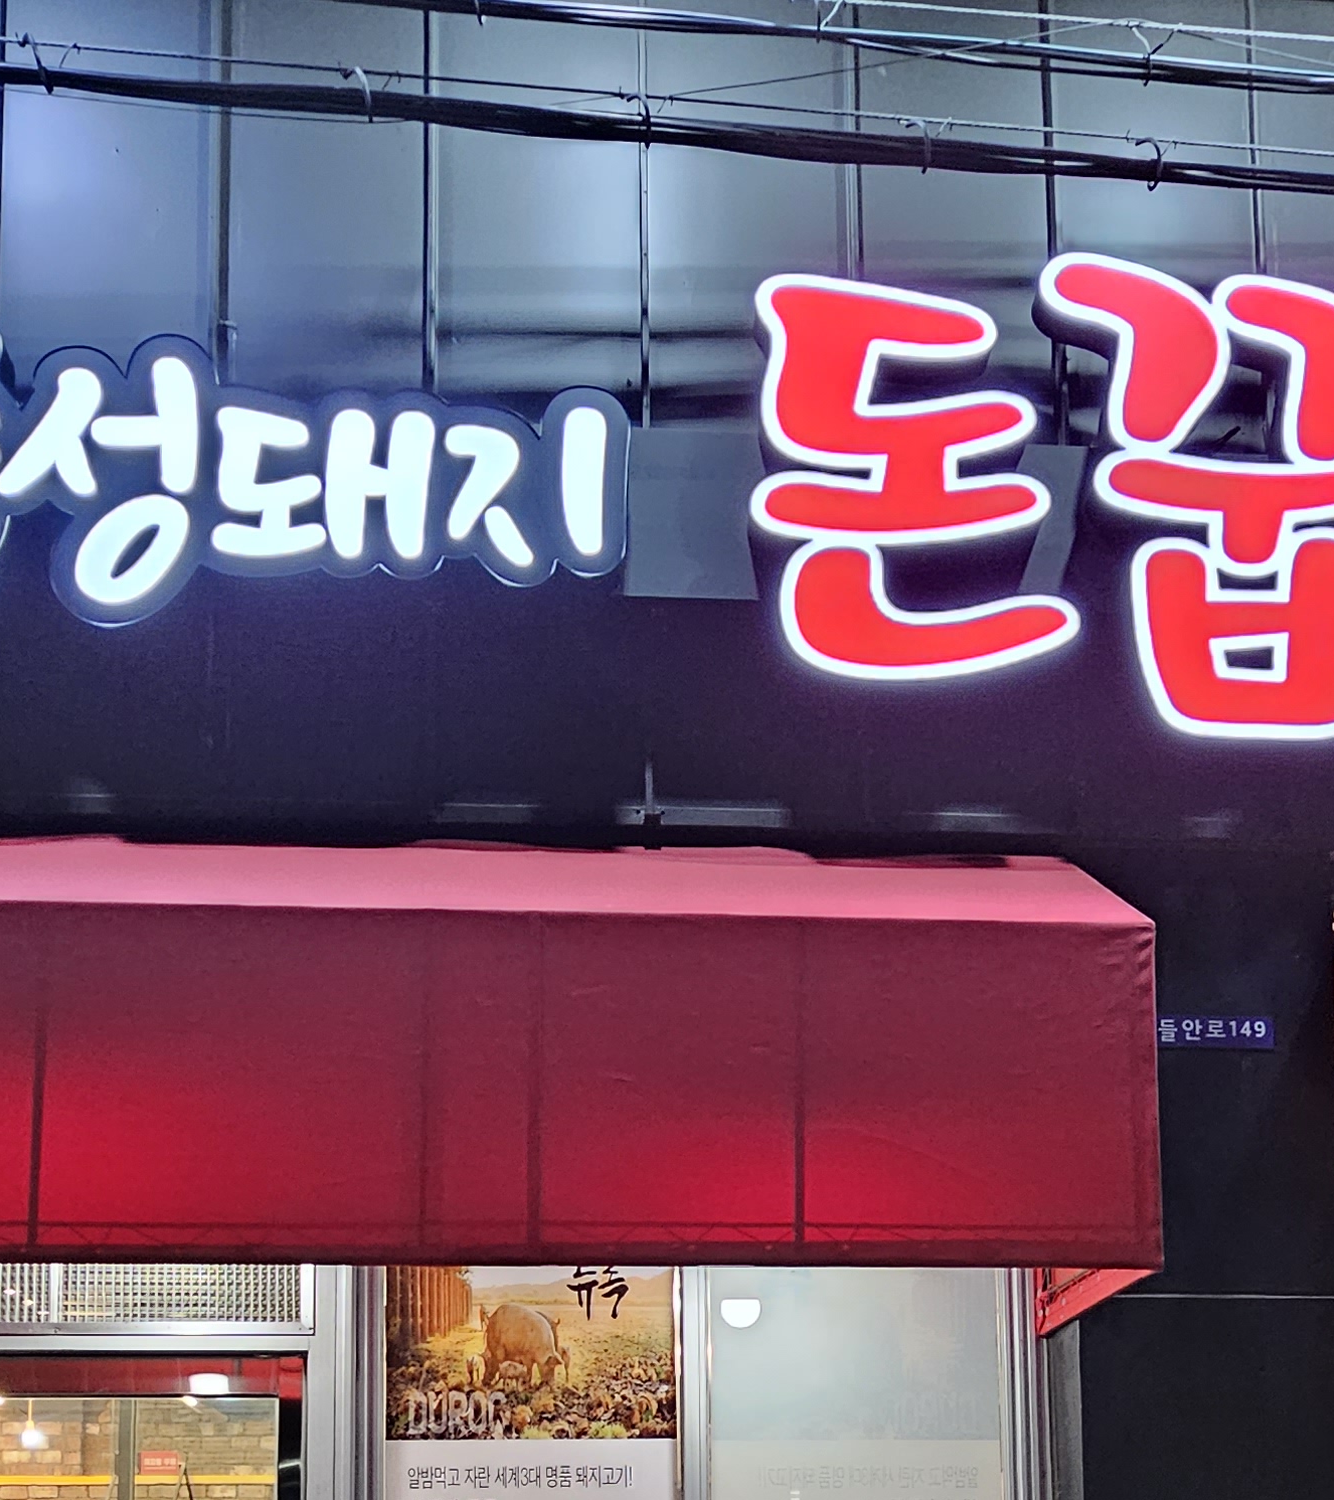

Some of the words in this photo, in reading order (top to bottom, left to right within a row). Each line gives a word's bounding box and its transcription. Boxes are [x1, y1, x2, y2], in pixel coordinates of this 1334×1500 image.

[407, 1466, 461, 1490] 알밤먹고
[464, 1465, 491, 1489] 자란
[494, 1465, 542, 1489] 세계3대
[545, 1465, 572, 1488] 명품
[575, 1464, 634, 1488] 돼지고기!
